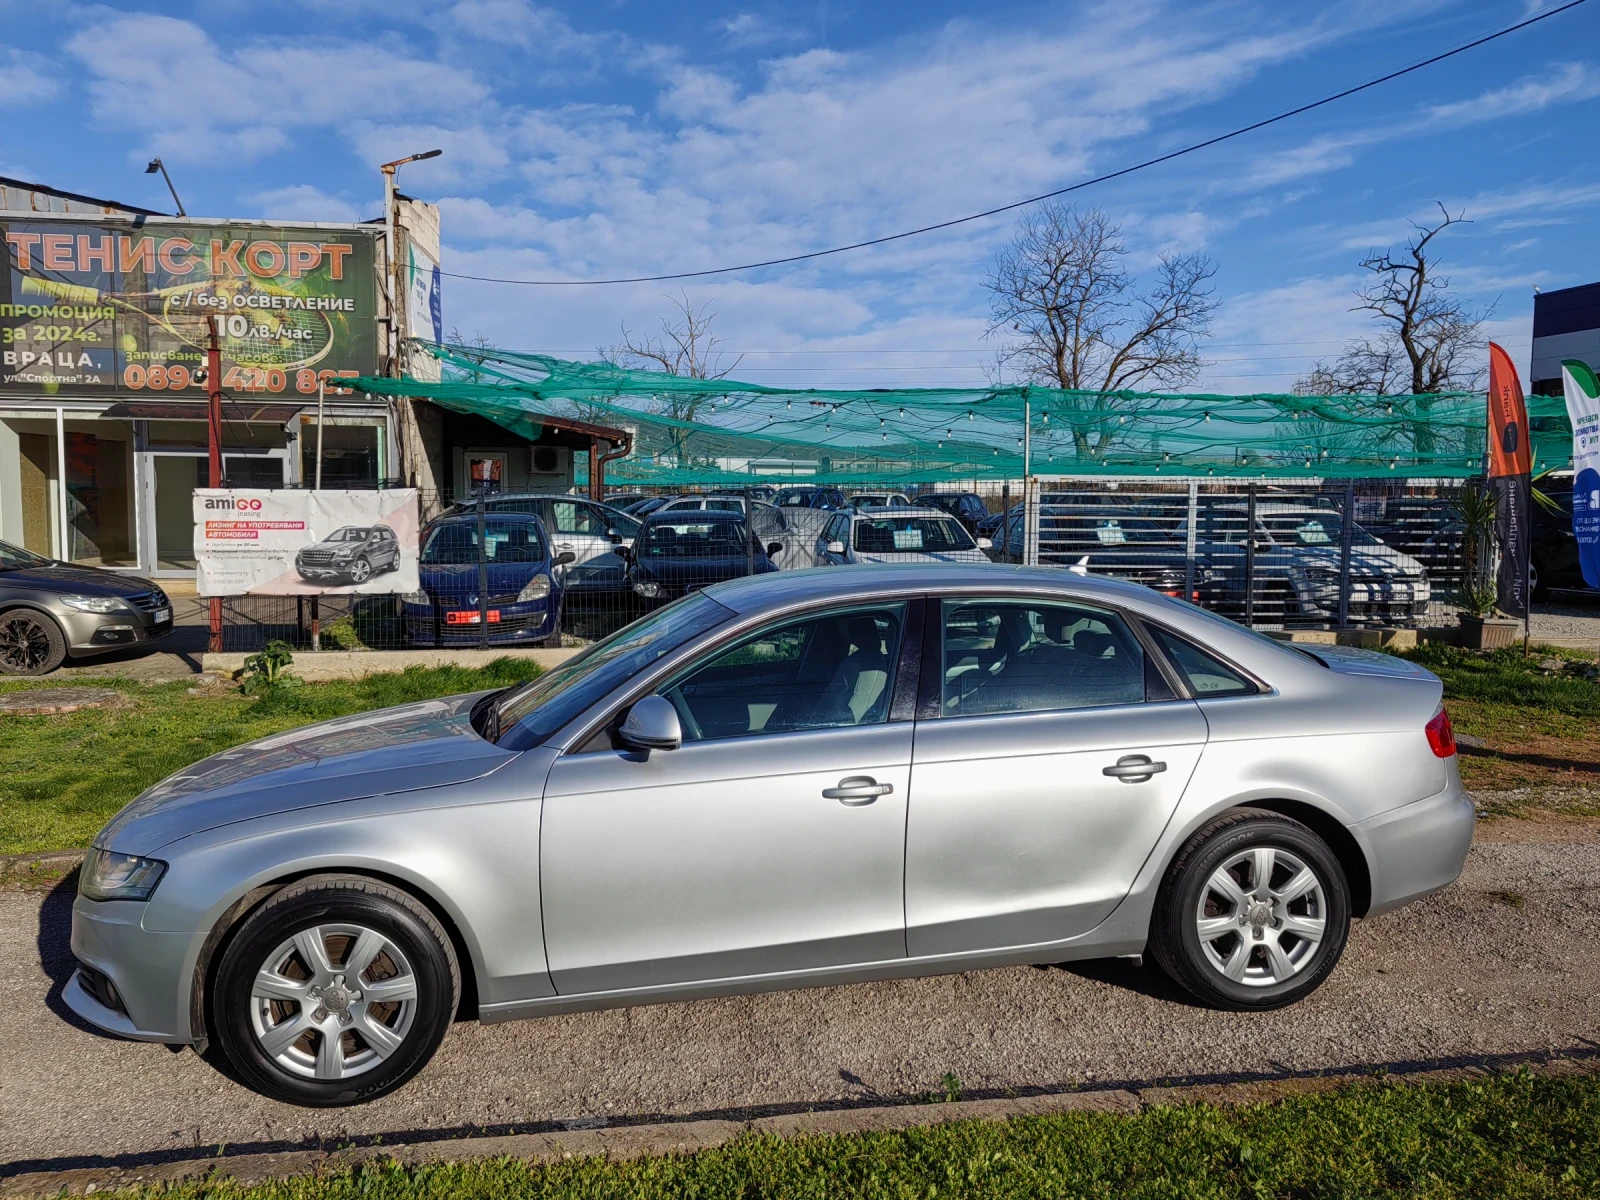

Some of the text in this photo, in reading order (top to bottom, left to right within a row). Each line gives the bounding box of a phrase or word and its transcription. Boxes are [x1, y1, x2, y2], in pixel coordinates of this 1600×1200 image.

[6, 232, 353, 280] ТЕНИС КОРТ
[197, 293, 229, 310] без
[232, 294, 355, 312] ОСВЕТЛЕНИЕ
[0, 304, 115, 321] ПРОМОЦИЯ
[2, 325, 103, 344] за 2024г.
[3, 350, 102, 369] ВРАЦА,
[125, 350, 203, 362] записване
[227, 353, 283, 364] часове:
[221, 366, 287, 392] 420
[237, 510, 262, 518] leasing
